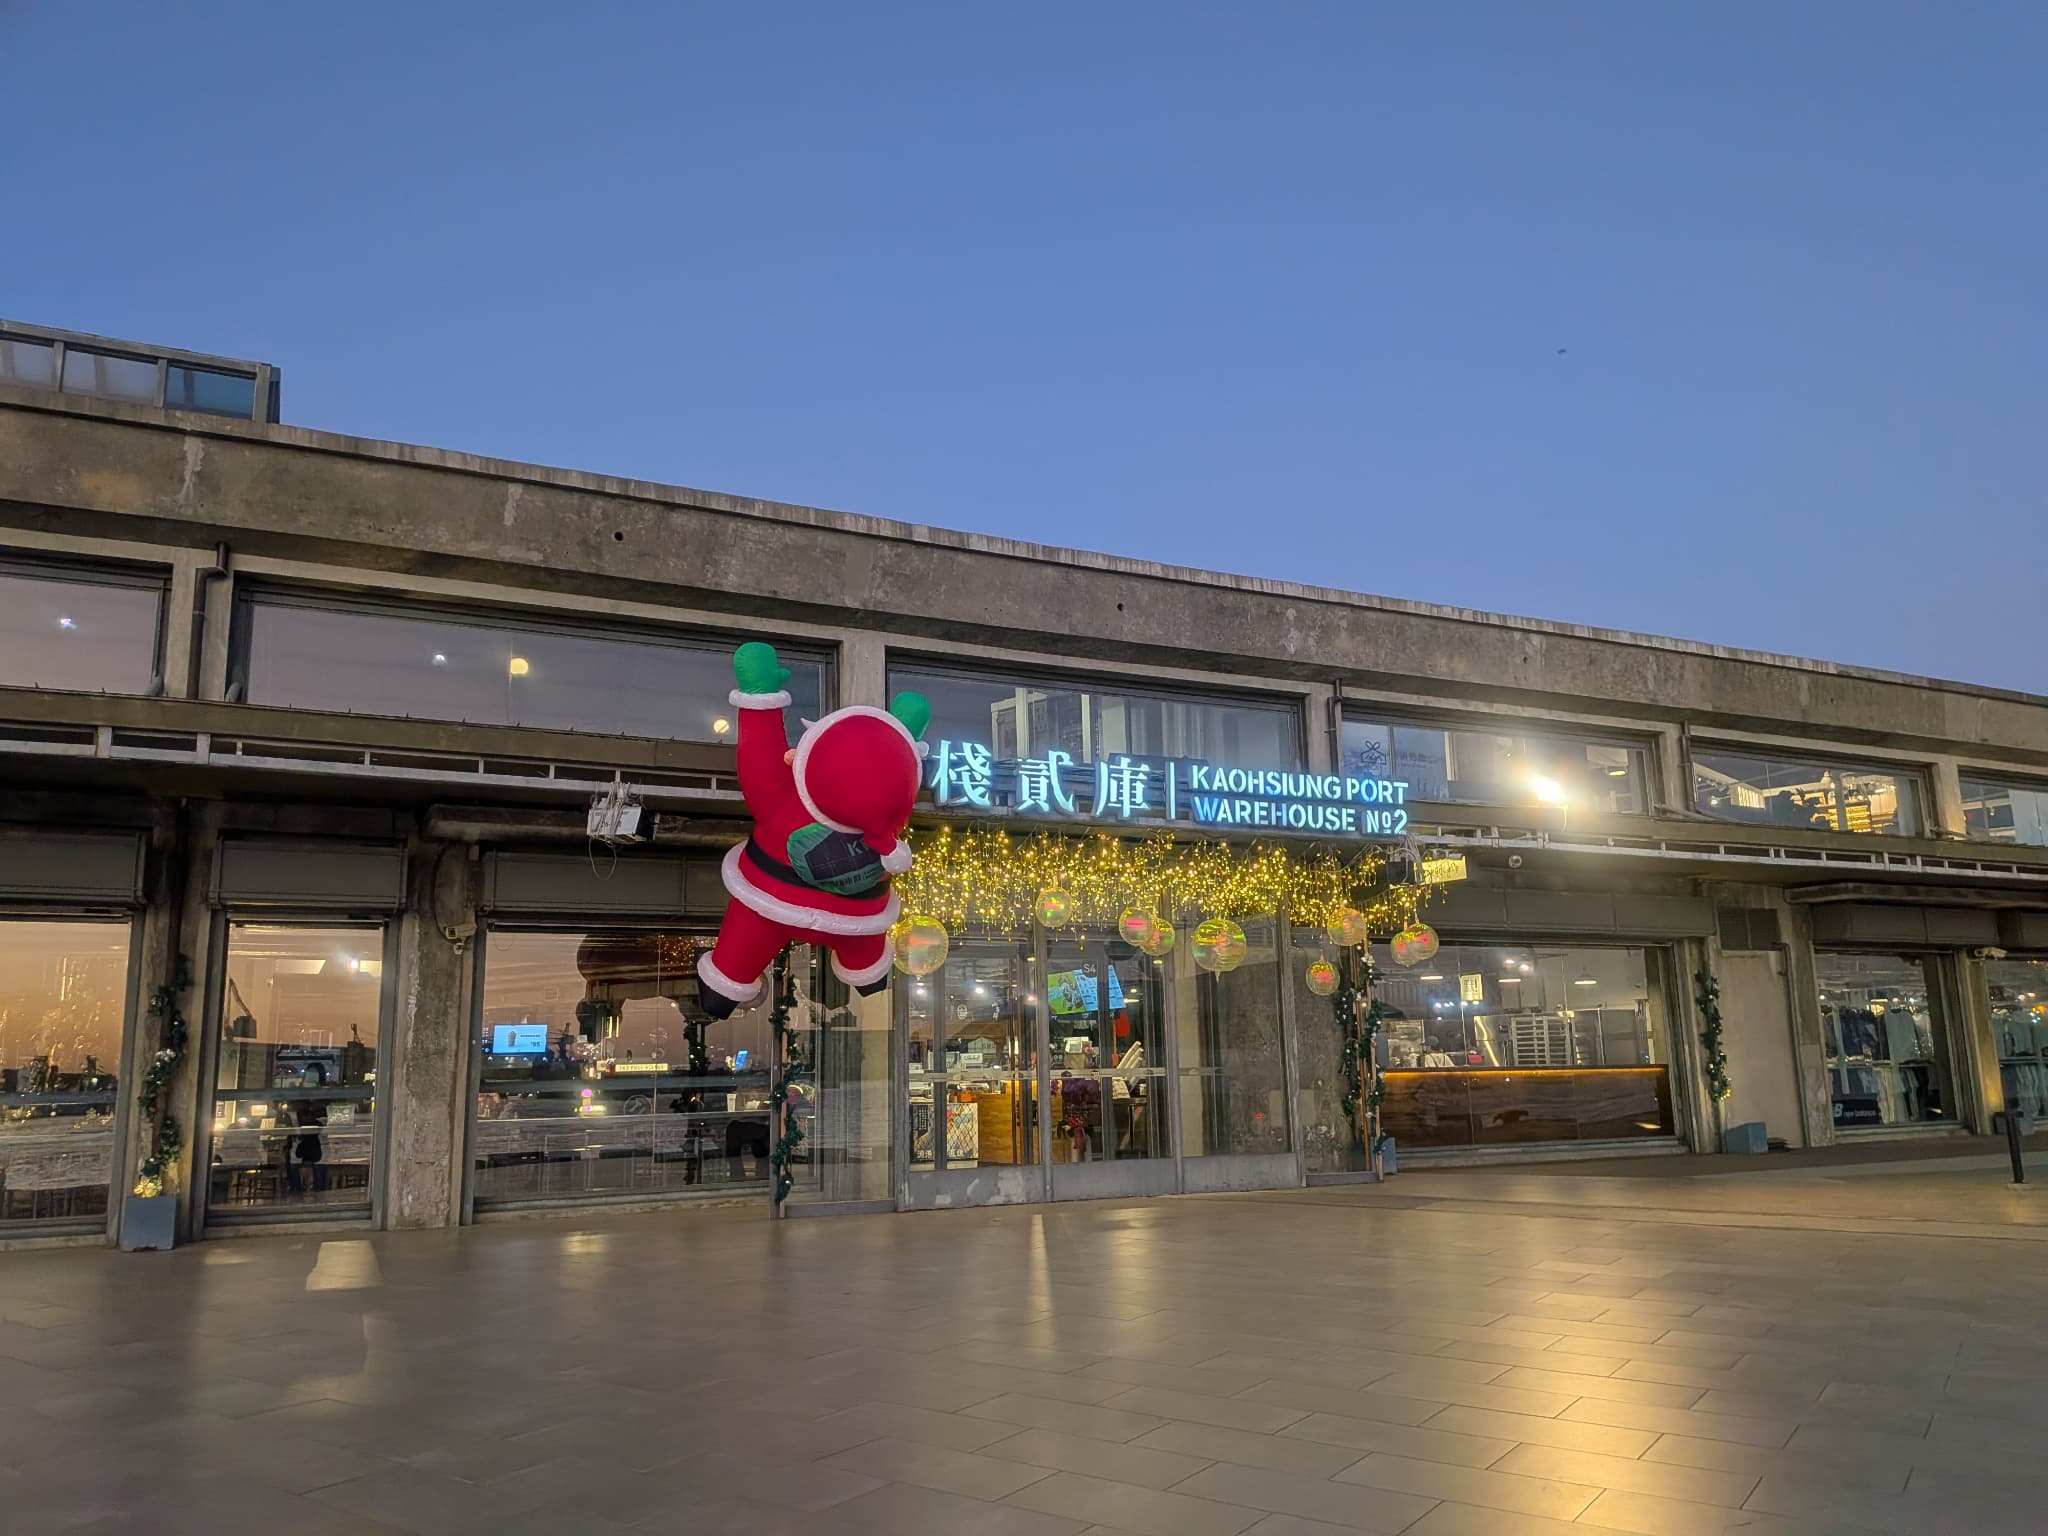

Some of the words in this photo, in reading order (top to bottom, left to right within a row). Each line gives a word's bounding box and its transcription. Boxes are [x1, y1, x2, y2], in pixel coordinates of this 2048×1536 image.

[931, 739, 1151, 818] 棧貳庫
[1191, 764, 1342, 801] KAOHSIUNG
[1346, 777, 1409, 805] PORT
[1194, 796, 1357, 832] WAREHOUSE
[846, 840, 867, 857] K
[1083, 963, 1097, 974] S4
